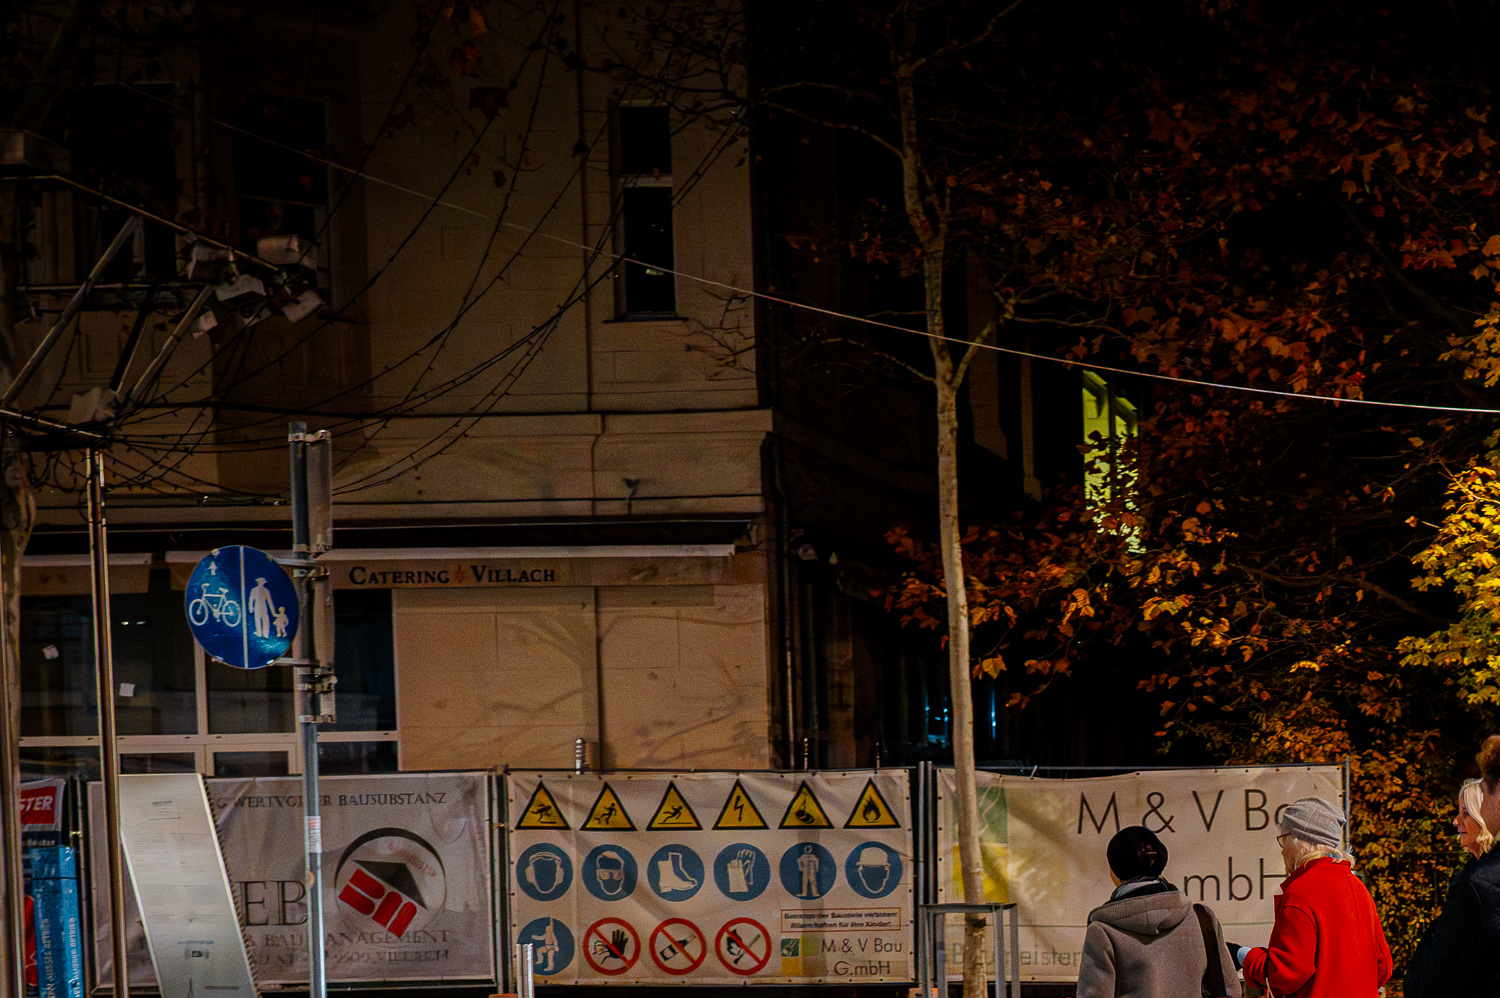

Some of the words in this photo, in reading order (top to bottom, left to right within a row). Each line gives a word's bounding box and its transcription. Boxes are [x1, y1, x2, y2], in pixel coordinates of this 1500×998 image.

[349, 566, 450, 585] CATERING
[471, 565, 556, 583] VILLACH
[339, 792, 447, 806] BAUSUBSTANZ
[1077, 791, 1121, 834] M
[1142, 791, 1175, 834] &
[1192, 789, 1224, 833] V
[821, 939, 836, 953] M
[841, 938, 853, 953] &
[857, 938, 868, 952] V
[874, 937, 902, 953] Bau
